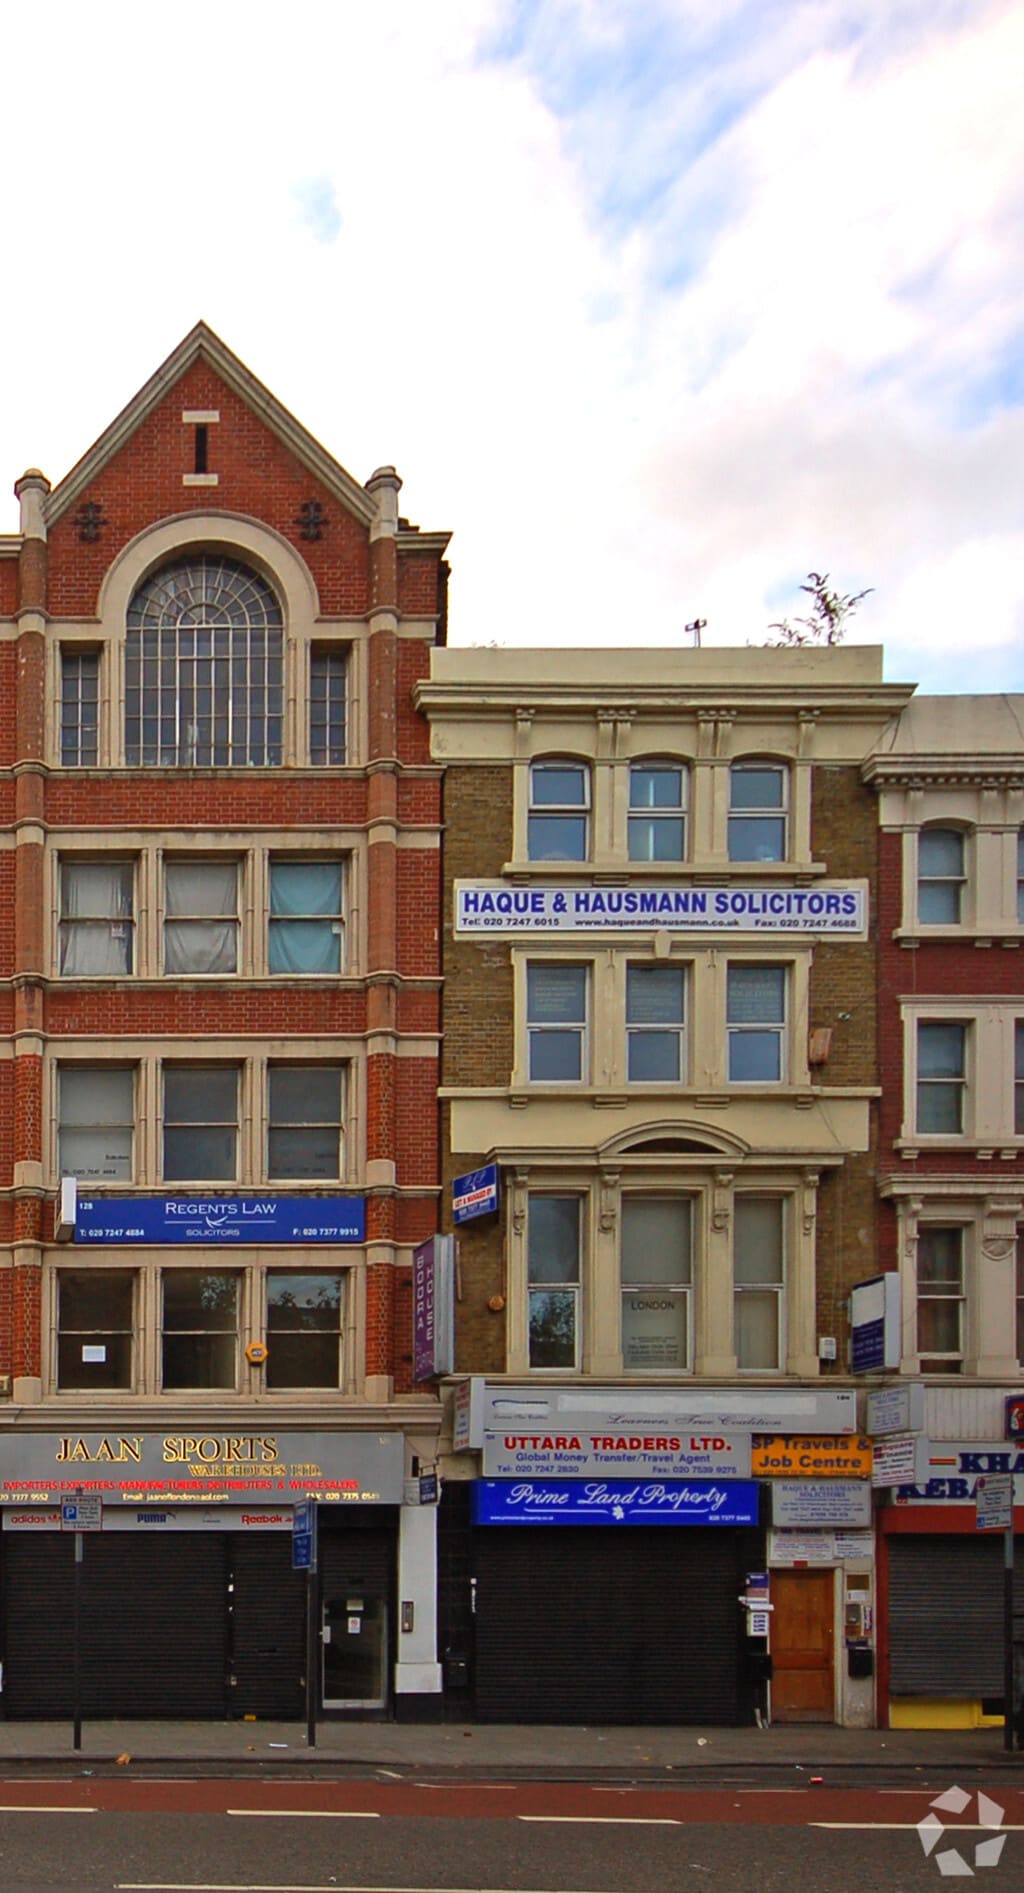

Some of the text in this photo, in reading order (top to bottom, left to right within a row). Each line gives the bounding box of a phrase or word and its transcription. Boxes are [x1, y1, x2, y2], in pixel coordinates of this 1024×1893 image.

[463, 893, 857, 914] HAQUE & HAUSMANN SOLICITORS
[484, 918, 503, 926] 020
[506, 918, 531, 926] 7247
[780, 919, 799, 928] 020
[802, 919, 827, 928] 7247
[165, 1202, 277, 1215] REGENTS LAW
[185, 1229, 240, 1237] SOLICITORS
[631, 1301, 675, 1310] LONDON
[504, 1436, 732, 1451] UTTARA TRADERS LTD.
[752, 1435, 870, 1450] SP Travels &
[56, 1437, 279, 1463] JAAN SPORTS
[516, 1453, 550, 1461] Global
[554, 1453, 588, 1463] Money
[679, 1454, 711, 1464] Agent
[759, 1455, 862, 1468] Job Centre
[3, 1480, 57, 1490] IMPORTERS
[277, 1480, 284, 1490] &
[506, 1484, 728, 1511] Prime Land Property
[11, 1514, 46, 1524] adidas
[137, 1513, 167, 1523] PUMA
[241, 1514, 283, 1524] Reebok
